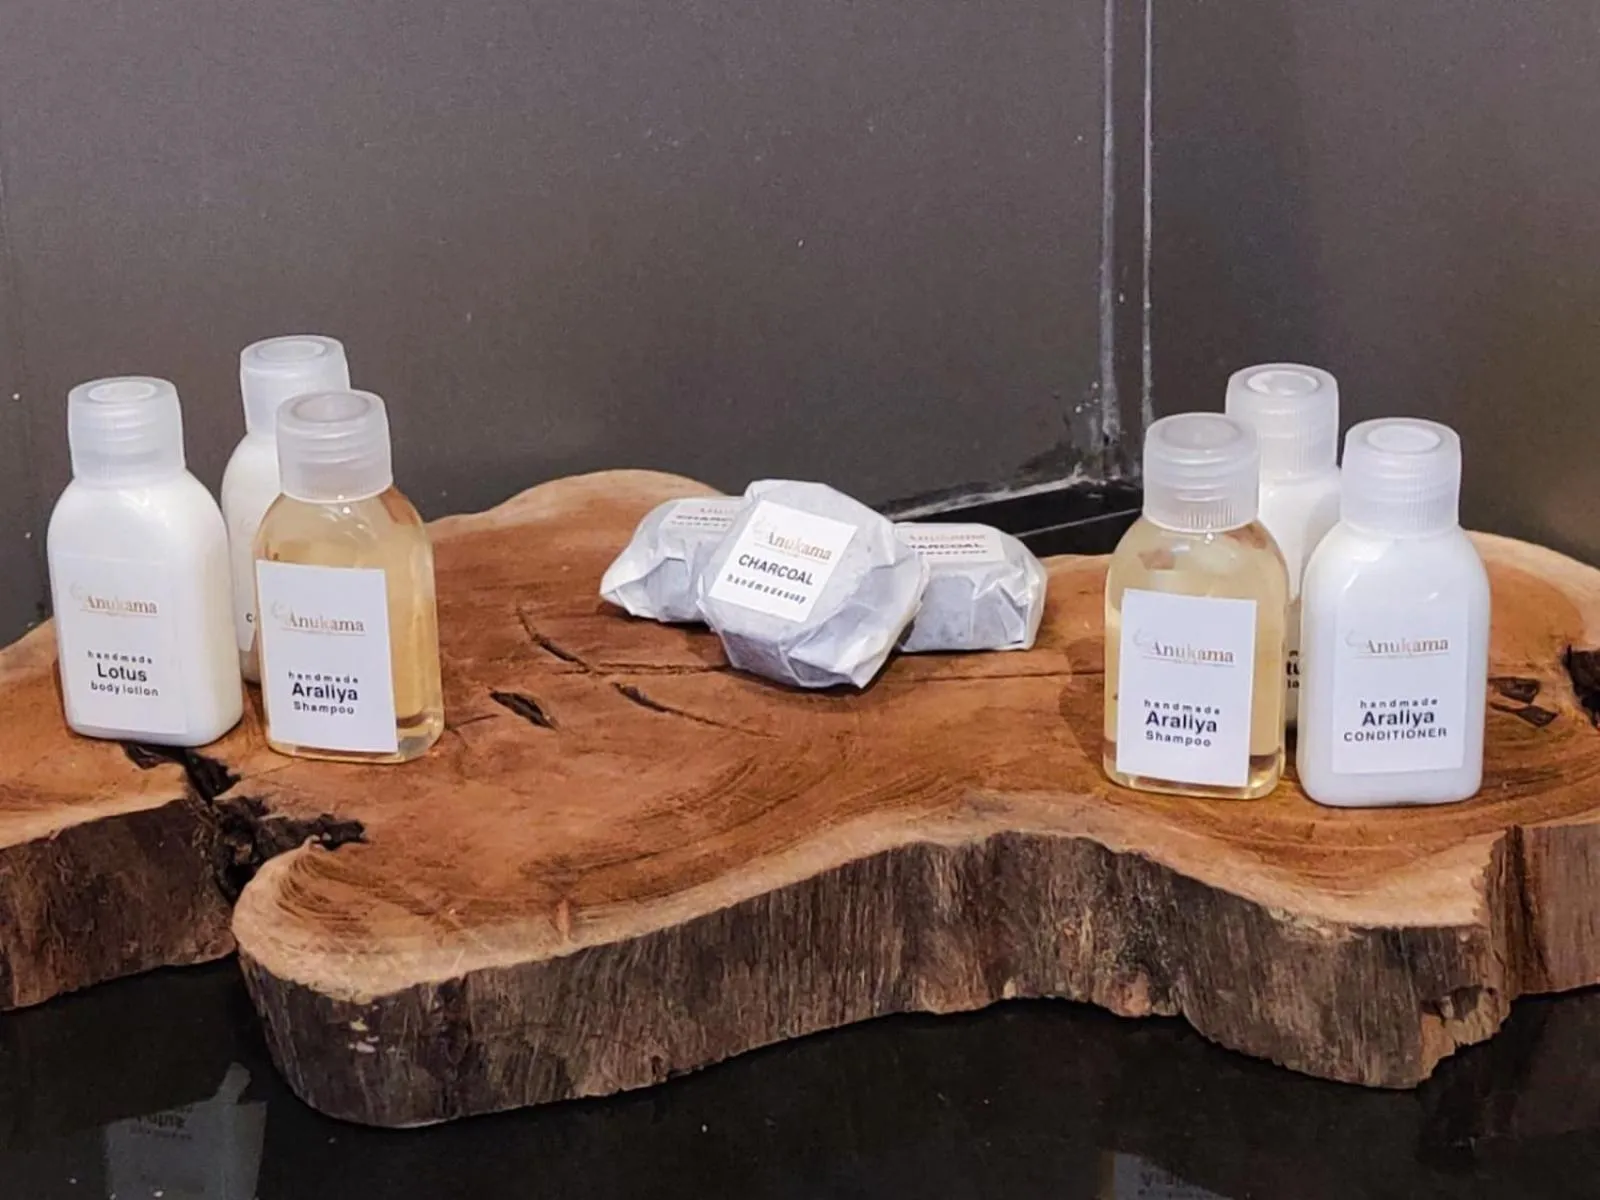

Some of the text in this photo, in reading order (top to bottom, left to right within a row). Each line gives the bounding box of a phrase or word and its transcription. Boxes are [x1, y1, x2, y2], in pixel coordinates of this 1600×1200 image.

[766, 531, 833, 561] Anukama
[738, 553, 814, 586] CHARCOAL
[84, 595, 158, 615] Anukama
[286, 611, 365, 632] Anukama
[1152, 641, 1234, 663] Anukama
[1365, 637, 1449, 655] Anukama
[88, 650, 152, 664] handmade
[96, 662, 148, 682] Lotus
[288, 671, 358, 684] handmade
[91, 680, 159, 697] body lotion
[292, 682, 358, 703] Araliya
[293, 700, 355, 715] Shampoo
[1144, 699, 1221, 715] handmade
[1360, 698, 1438, 709] handmade
[1145, 711, 1218, 735] Araliya
[1362, 710, 1435, 728] Araliya
[1145, 730, 1212, 747] Shampoo
[1343, 727, 1448, 742] CONDITIONER
